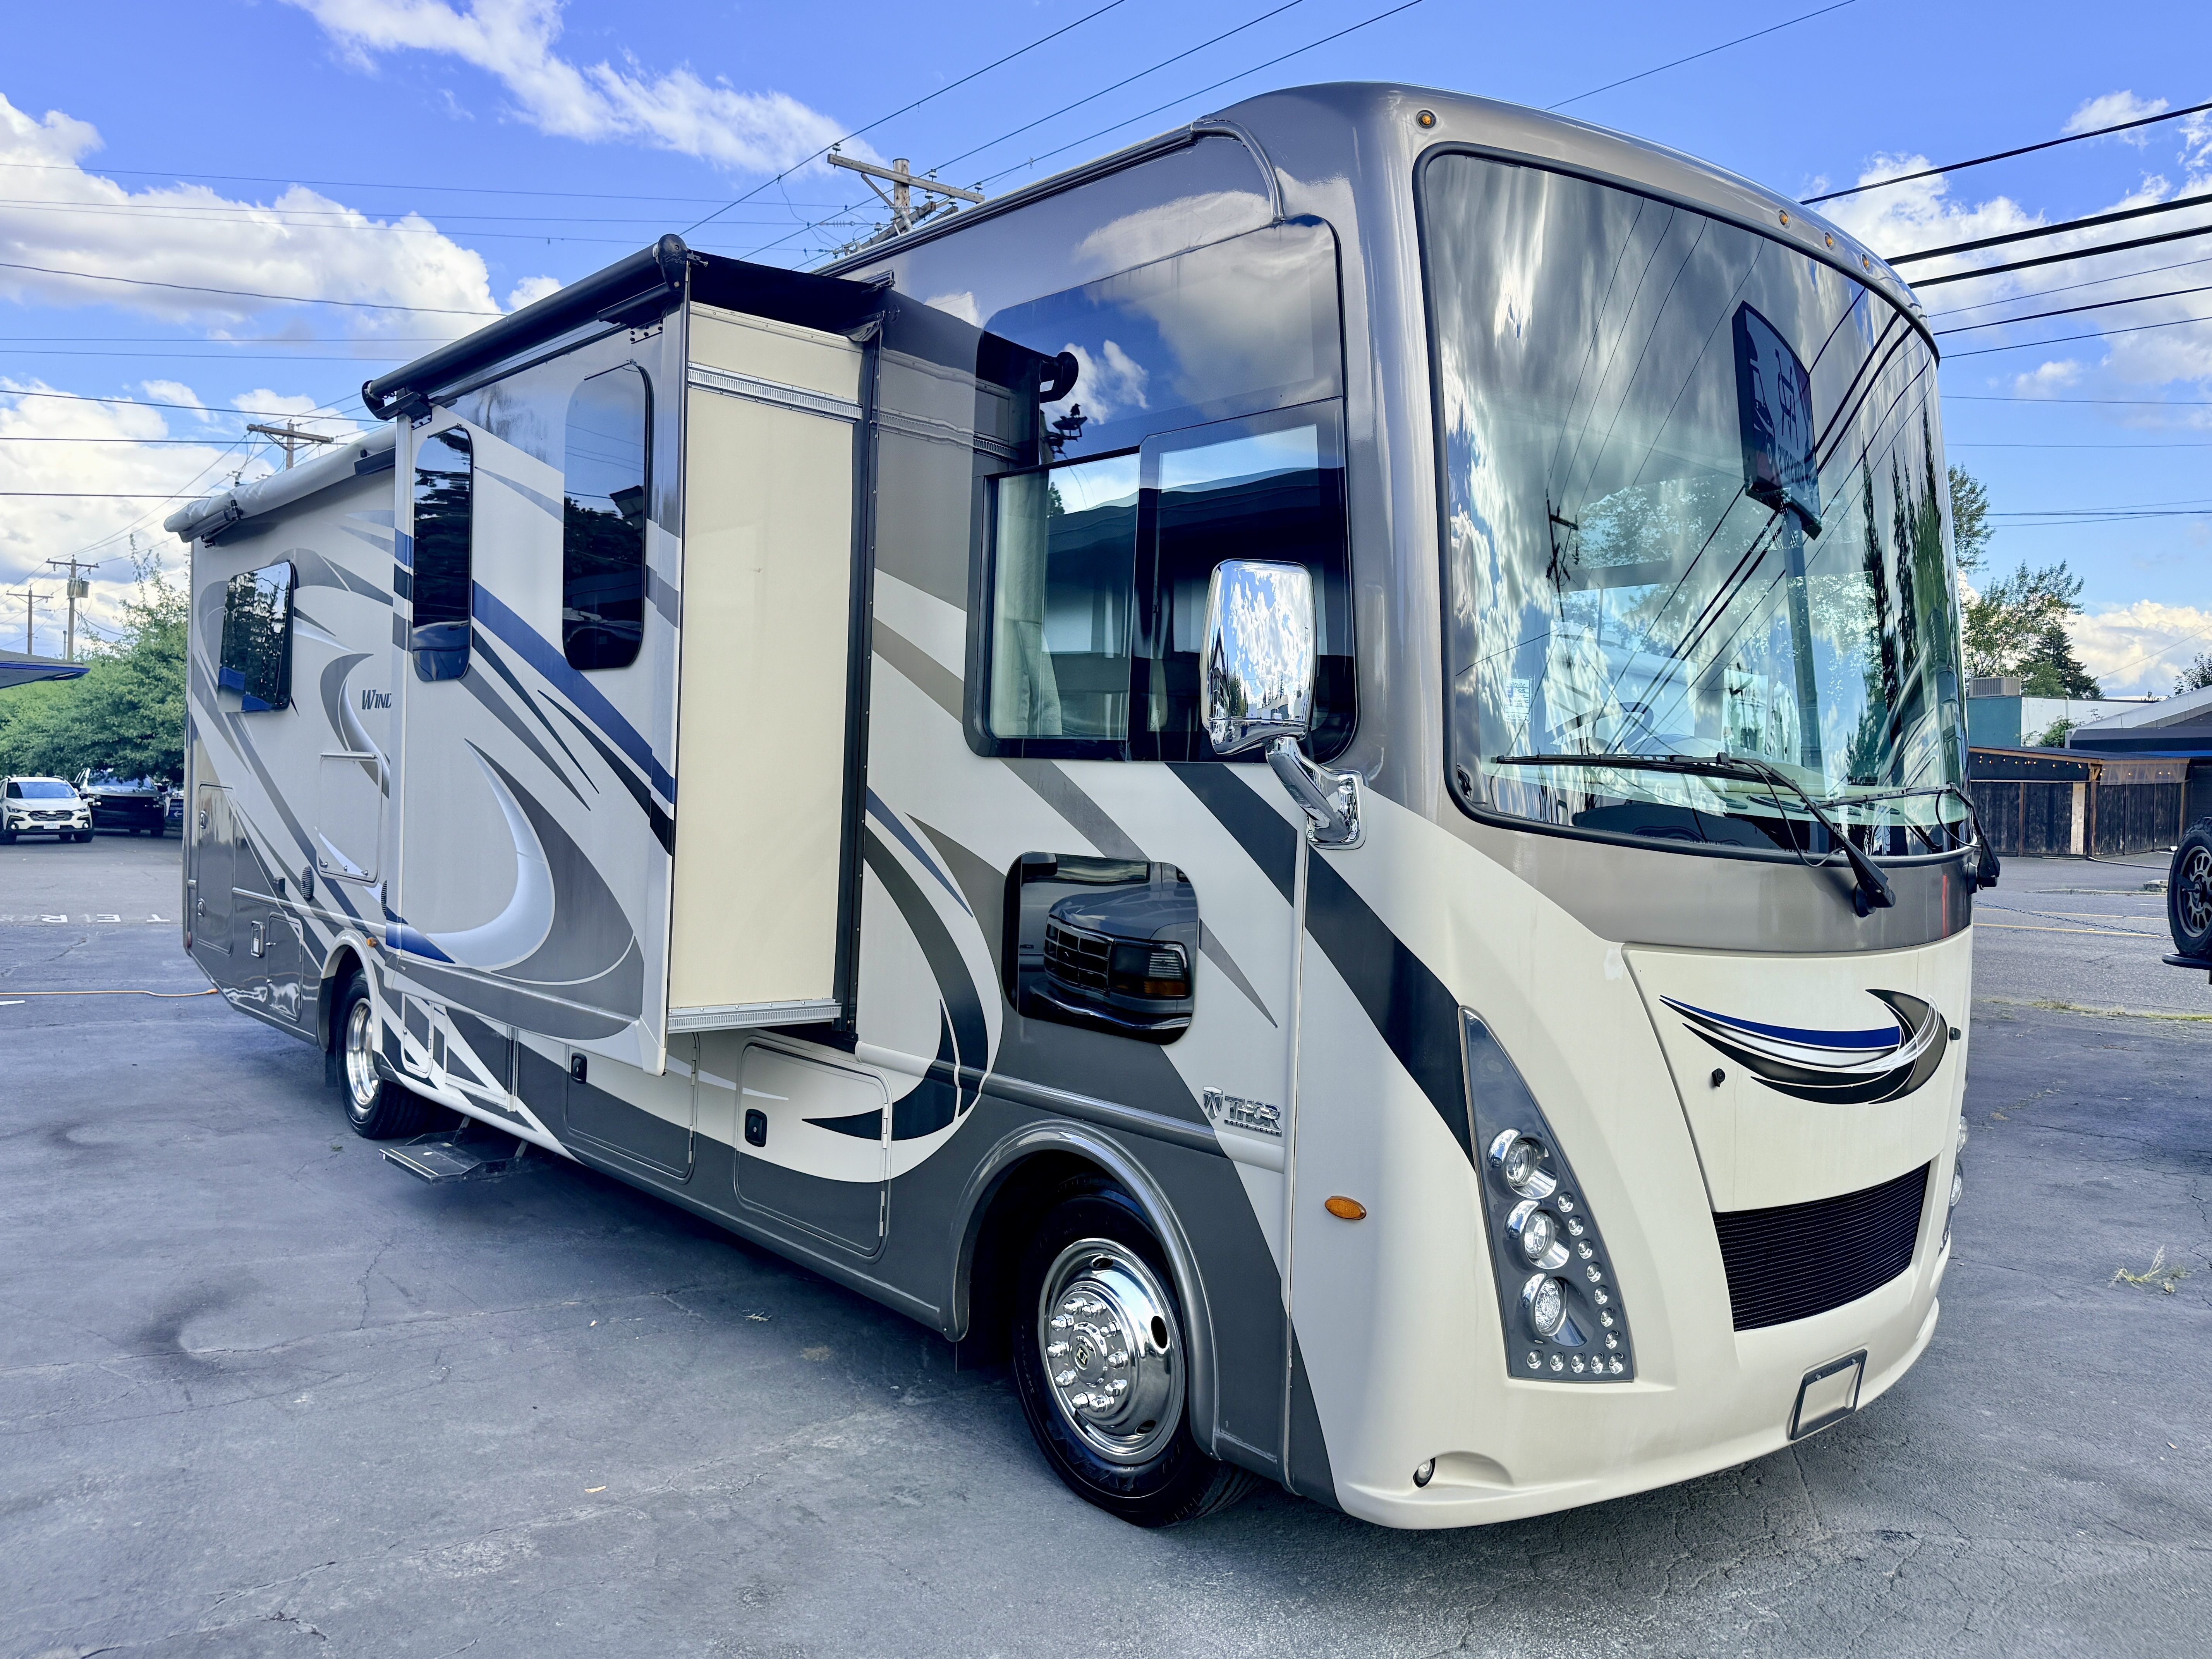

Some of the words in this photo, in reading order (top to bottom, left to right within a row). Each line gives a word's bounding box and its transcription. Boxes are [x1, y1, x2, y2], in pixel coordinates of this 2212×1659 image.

[1224, 1094, 1281, 1130] THOR
[1224, 1119, 1249, 1129] MOTOR
[1254, 1127, 1281, 1136] COACH
